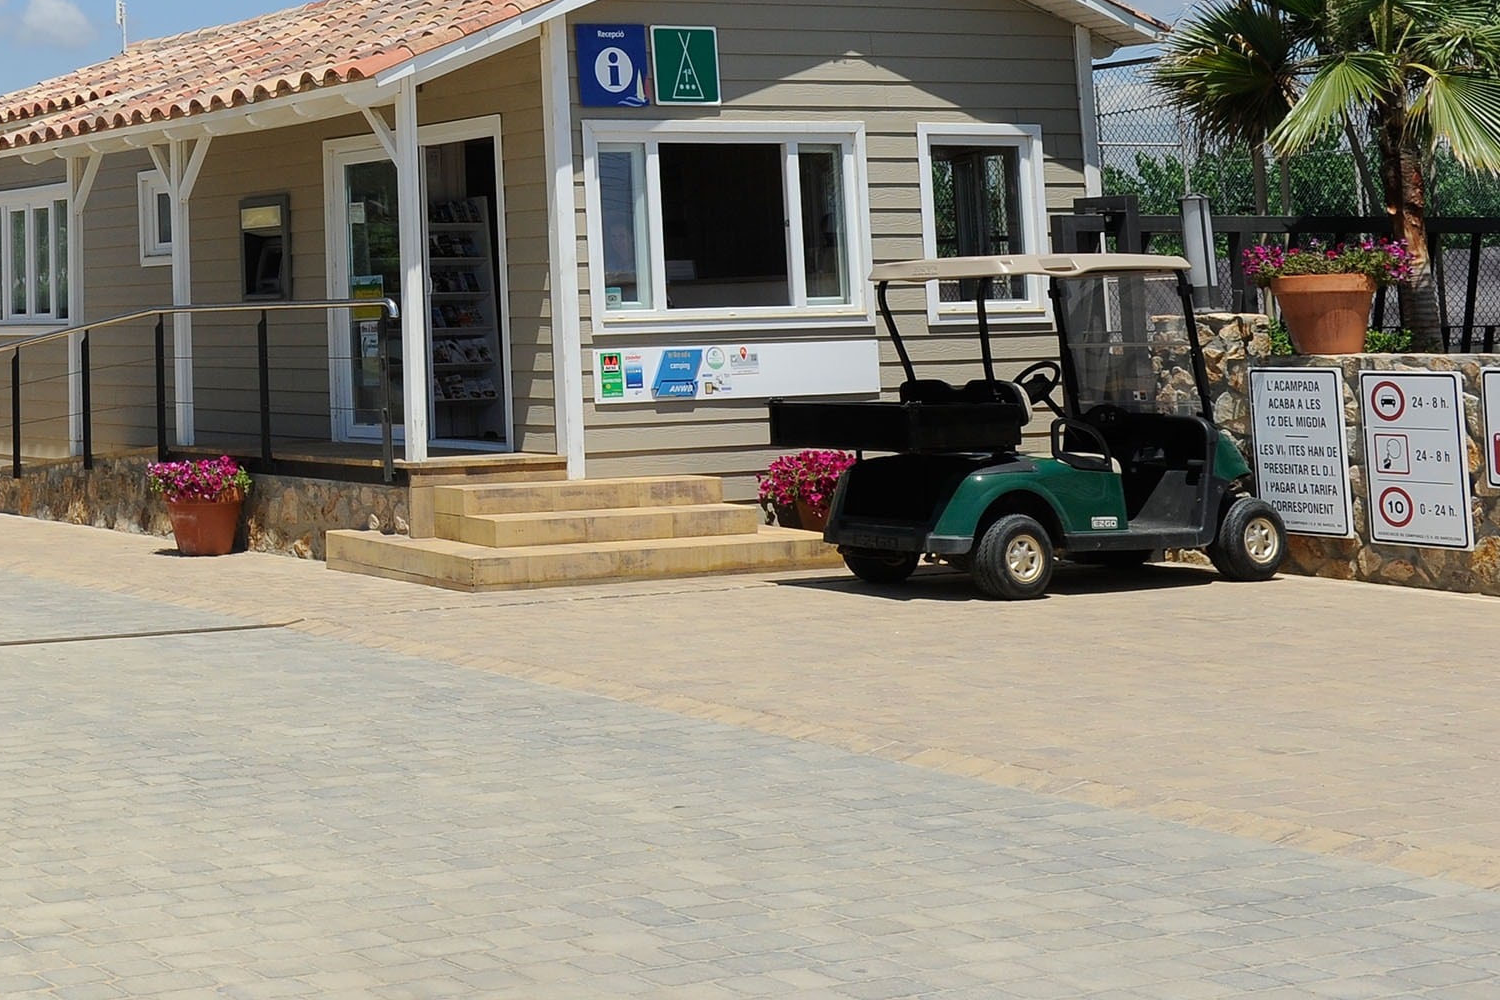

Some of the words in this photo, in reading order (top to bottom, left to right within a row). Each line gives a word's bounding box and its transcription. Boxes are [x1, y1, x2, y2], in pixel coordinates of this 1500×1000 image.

[597, 30, 625, 39] Recepció
[1266, 380, 1320, 392] L'ACAMPADA
[1268, 398, 1296, 409] ACABA
[1297, 398, 1304, 410] A
[1305, 399, 1322, 410] LES
[1412, 396, 1423, 408] 24
[1432, 397, 1438, 408] 8
[1440, 397, 1449, 408] h.
[1266, 416, 1276, 427] 12
[1278, 416, 1293, 427] DEL
[1296, 416, 1327, 428] MIGDIA
[1260, 444, 1274, 456] LES
[1275, 445, 1306, 457] VIITES
[1308, 446, 1325, 457] HAN
[1327, 446, 1338, 458] DE
[1416, 450, 1427, 461] 24
[1436, 451, 1442, 462] 8
[1311, 465, 1321, 476] EL
[1265, 481, 1269, 492] I
[1270, 482, 1296, 493] PAGAR
[1298, 483, 1309, 494] LA
[1310, 483, 1338, 496] TARIFA
[1271, 500, 1334, 515] CORRESPONENT
[1388, 501, 1404, 514] 10
[1420, 503, 1426, 515] 0
[1435, 504, 1446, 516] 24
[1449, 505, 1458, 517] h.
